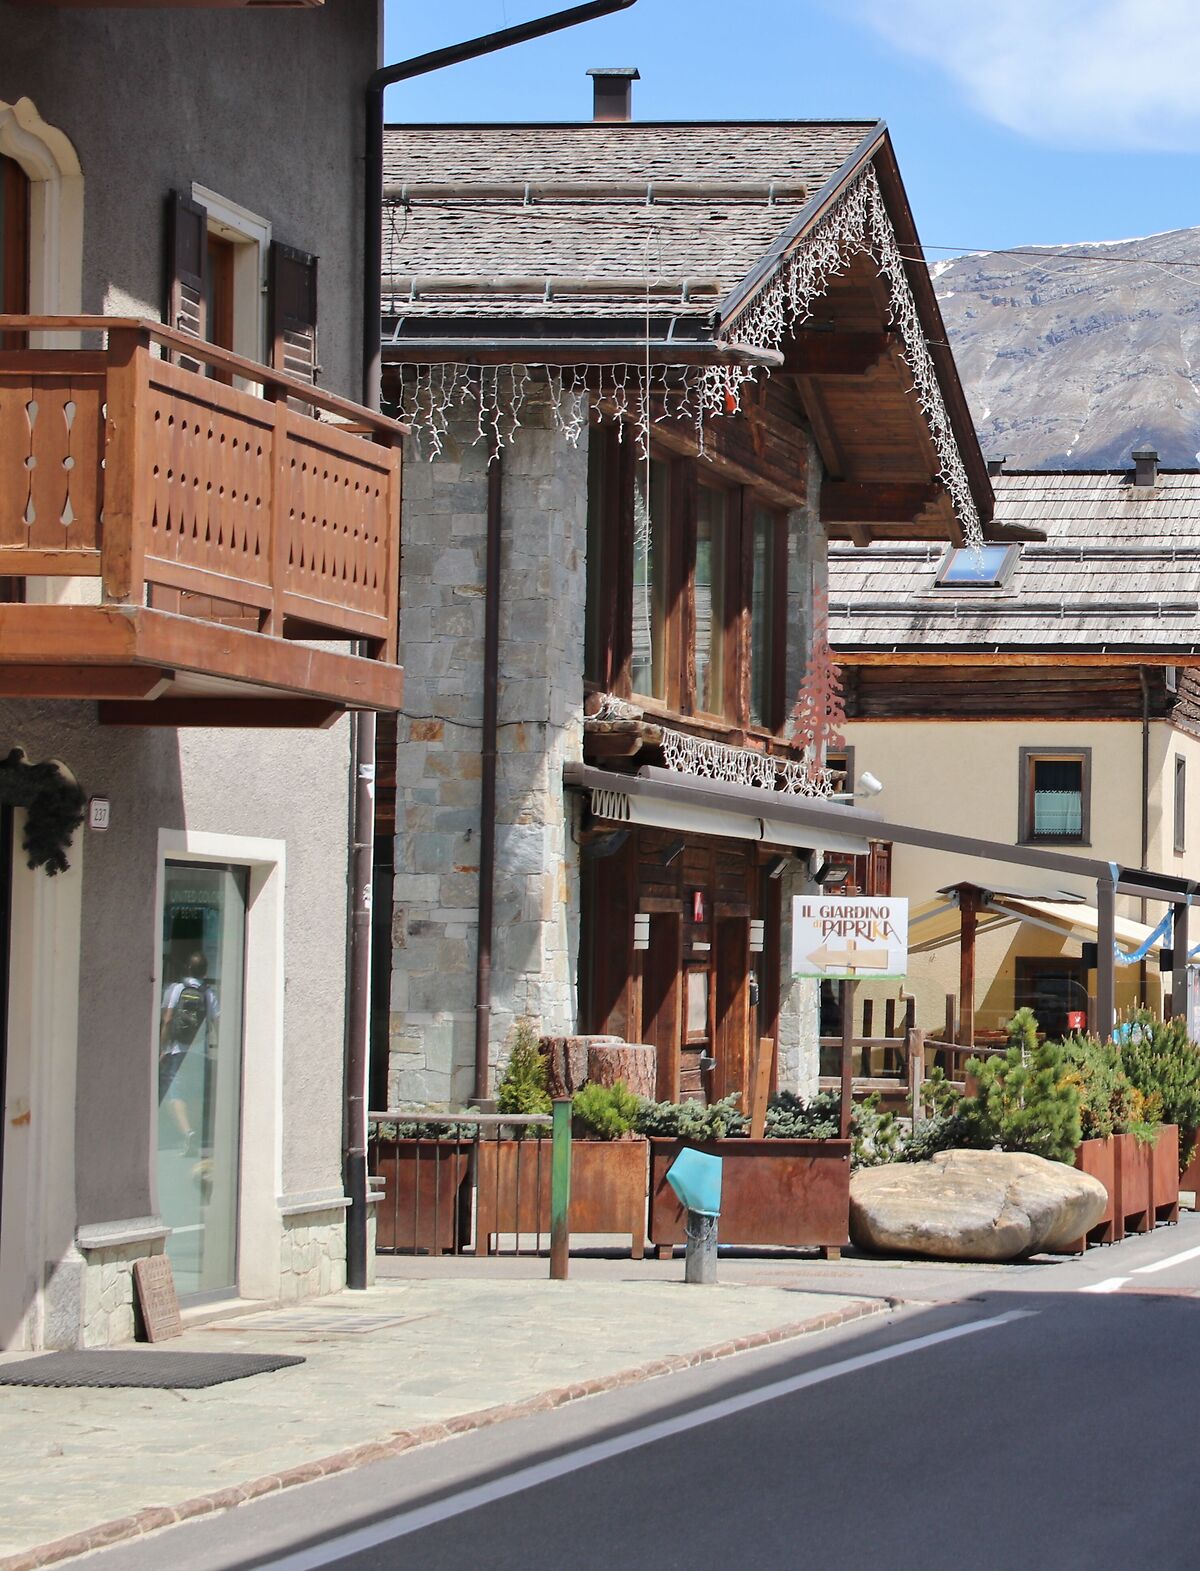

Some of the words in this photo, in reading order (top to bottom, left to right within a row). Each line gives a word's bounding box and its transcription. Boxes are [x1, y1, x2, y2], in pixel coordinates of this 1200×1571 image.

[802, 904, 816, 918] IL
[819, 904, 891, 919] GIARDINO
[813, 920, 822, 928] di
[822, 919, 902, 944] PAPRIKA
